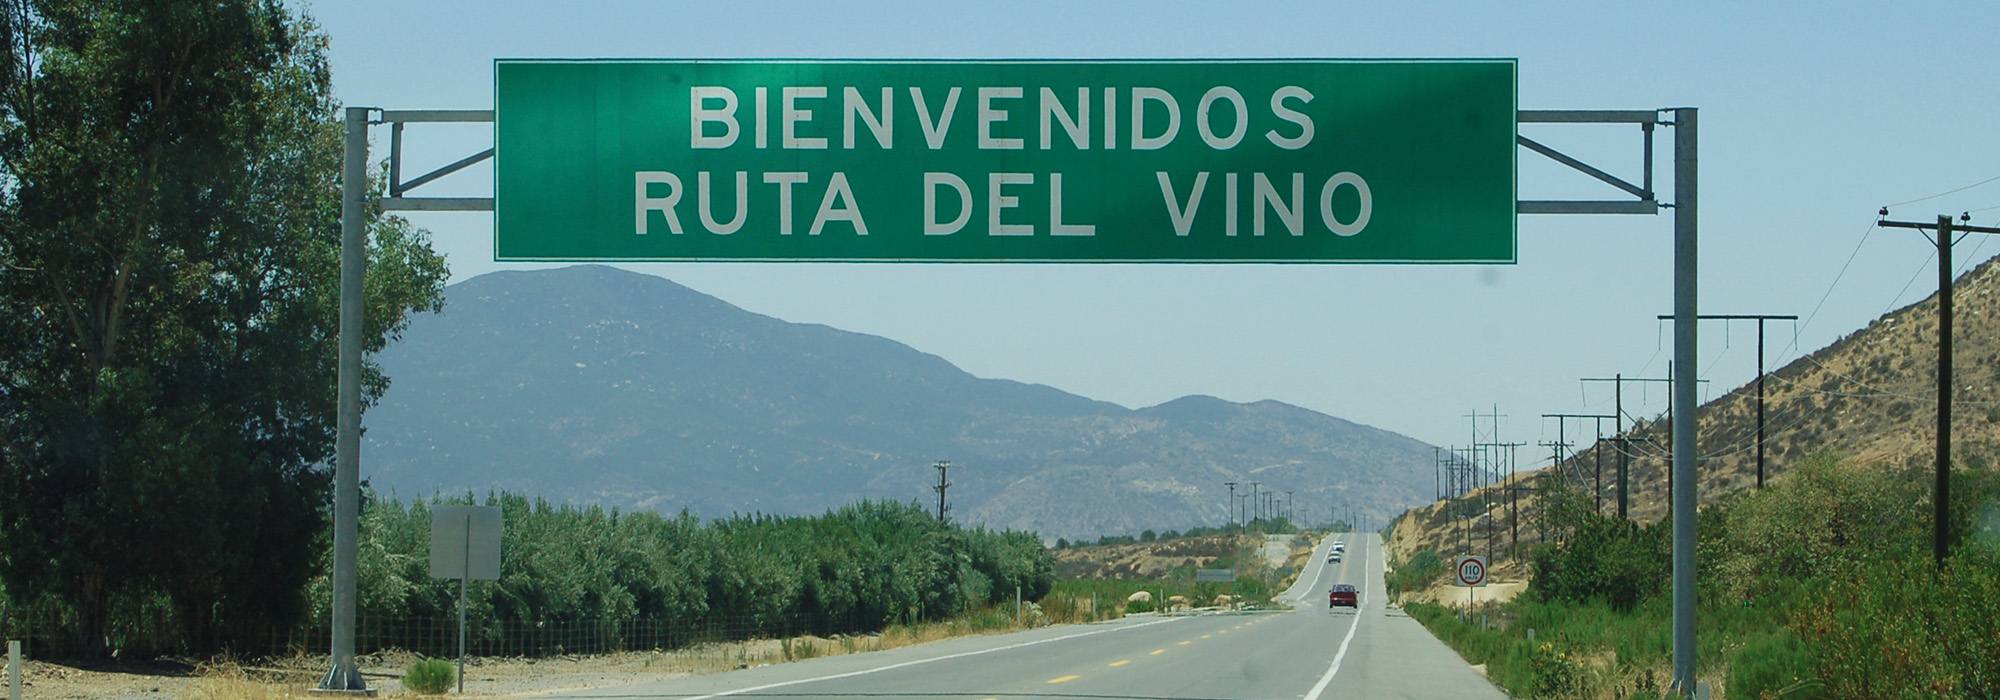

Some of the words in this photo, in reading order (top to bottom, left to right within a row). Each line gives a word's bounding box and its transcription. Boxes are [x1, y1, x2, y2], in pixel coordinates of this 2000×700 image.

[690, 86, 1315, 149] BIENVENIDOS
[635, 171, 869, 235] RUTA
[924, 172, 1096, 236] DEL
[1156, 171, 1373, 236] VINO
[1464, 565, 1480, 575] 110
